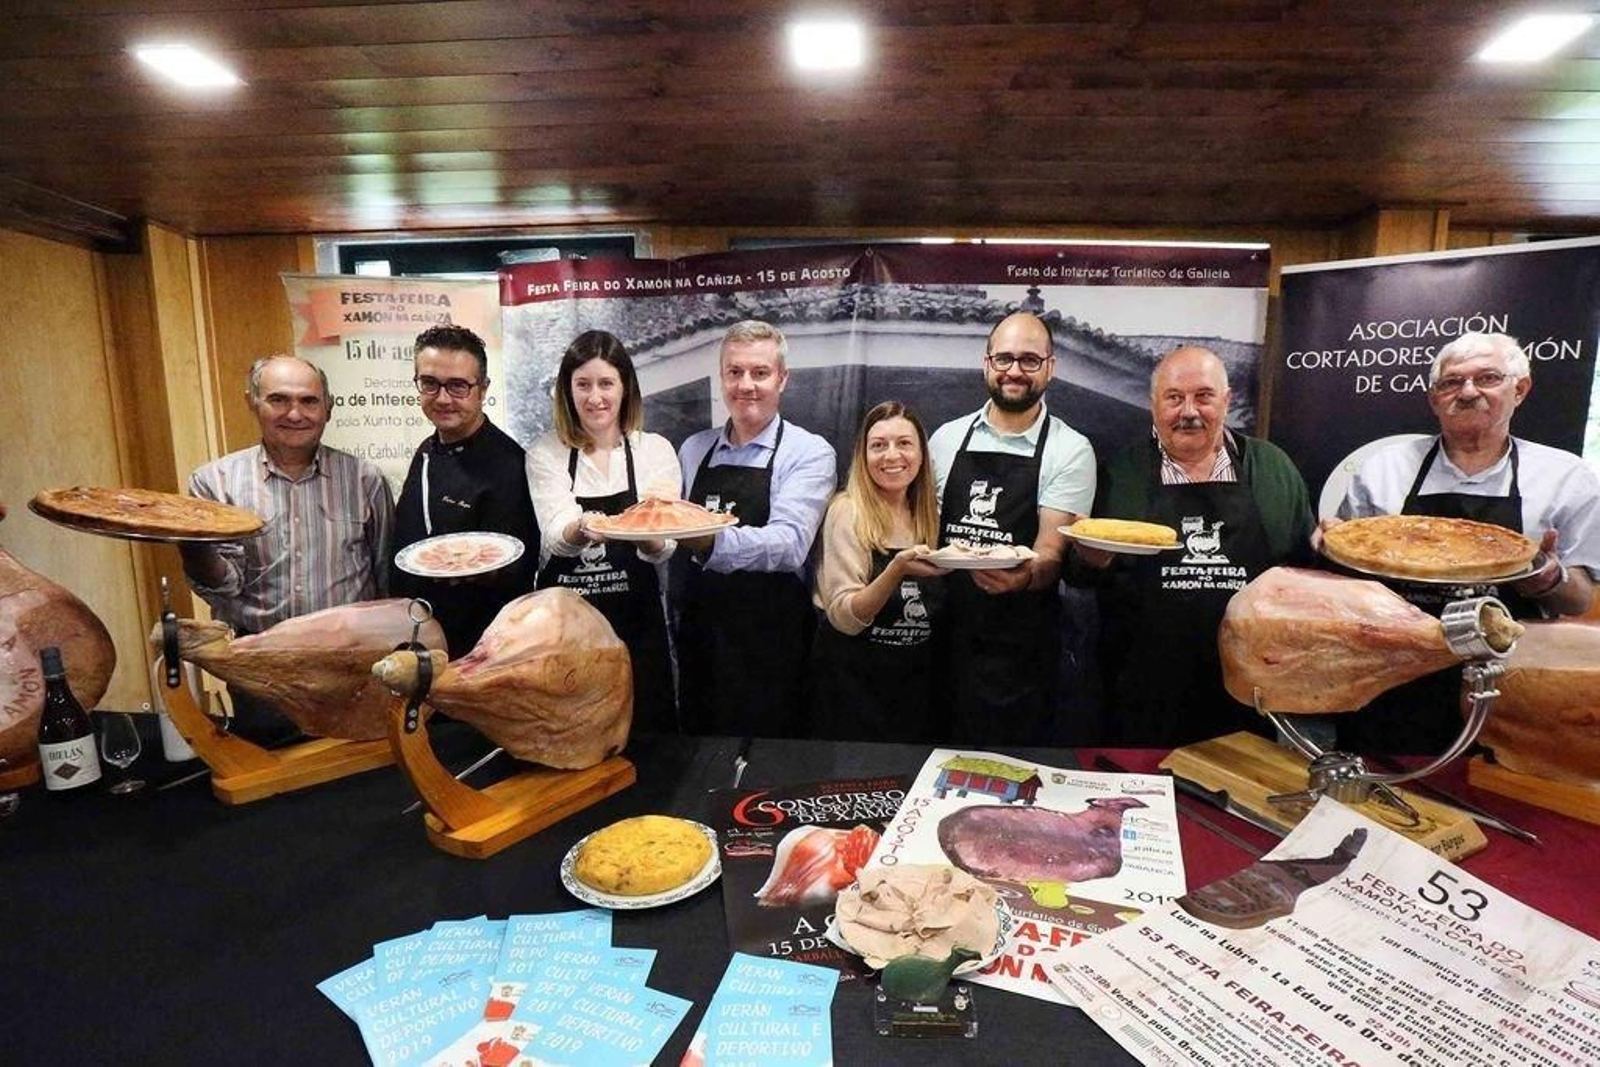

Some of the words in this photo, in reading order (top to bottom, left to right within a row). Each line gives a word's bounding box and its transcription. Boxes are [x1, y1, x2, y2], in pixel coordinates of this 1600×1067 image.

[528, 284, 560, 296] FESTA
[564, 280, 599, 292] FEIRA
[604, 281, 620, 290] DO
[626, 276, 672, 290] XAMÓN
[676, 278, 691, 288] NA
[696, 274, 742, 286] CAÑIZA
[756, 270, 775, 282] 15
[781, 271, 796, 281] DE
[801, 268, 850, 280] AGOSTO
[1006, 264, 1040, 277] Festa
[1043, 265, 1058, 277] de
[1061, 266, 1109, 278] Interese
[1169, 268, 1183, 279] de
[1186, 267, 1230, 279] Galicia
[1348, 312, 1508, 341] ASOCIACIÓN
[346, 340, 362, 360] 15
[367, 340, 386, 360] de
[392, 346, 414, 361] ag
[1287, 346, 1434, 369] CORTADORES
[1356, 376, 1384, 394] DE
[1390, 374, 1434, 392] GA
[348, 394, 366, 406] de
[371, 393, 422, 406] Interes
[363, 415, 402, 427] Xunta
[406, 416, 424, 427] de
[732, 790, 785, 827] 6
[758, 789, 905, 812] CONCURSO
[912, 798, 930, 808] 15
[799, 812, 829, 824] DE
[880, 808, 922, 866] AGOSTO
[1417, 869, 1488, 922] 53
[794, 916, 816, 935] A
[1410, 913, 1443, 931] NA
[768, 941, 792, 956] 15
[799, 938, 828, 951] DE
[1136, 925, 1165, 944] 53
[1163, 941, 1223, 980] FESTA
[1488, 940, 1525, 961] DO
[1169, 909, 1200, 929] Luar
[1198, 927, 1218, 940] na
[1217, 938, 1260, 966] Lubre
[1270, 971, 1293, 986] La
[1290, 984, 1334, 1013] Edad
[1332, 1010, 1359, 1029] de
[1357, 1026, 1396, 1052] Oro
[1109, 987, 1151, 1019] Verbena
[1147, 1017, 1180, 1041] polas
[718, 1022, 800, 1036] CULTURAL
[716, 1040, 813, 1057] DEPORTIVO
